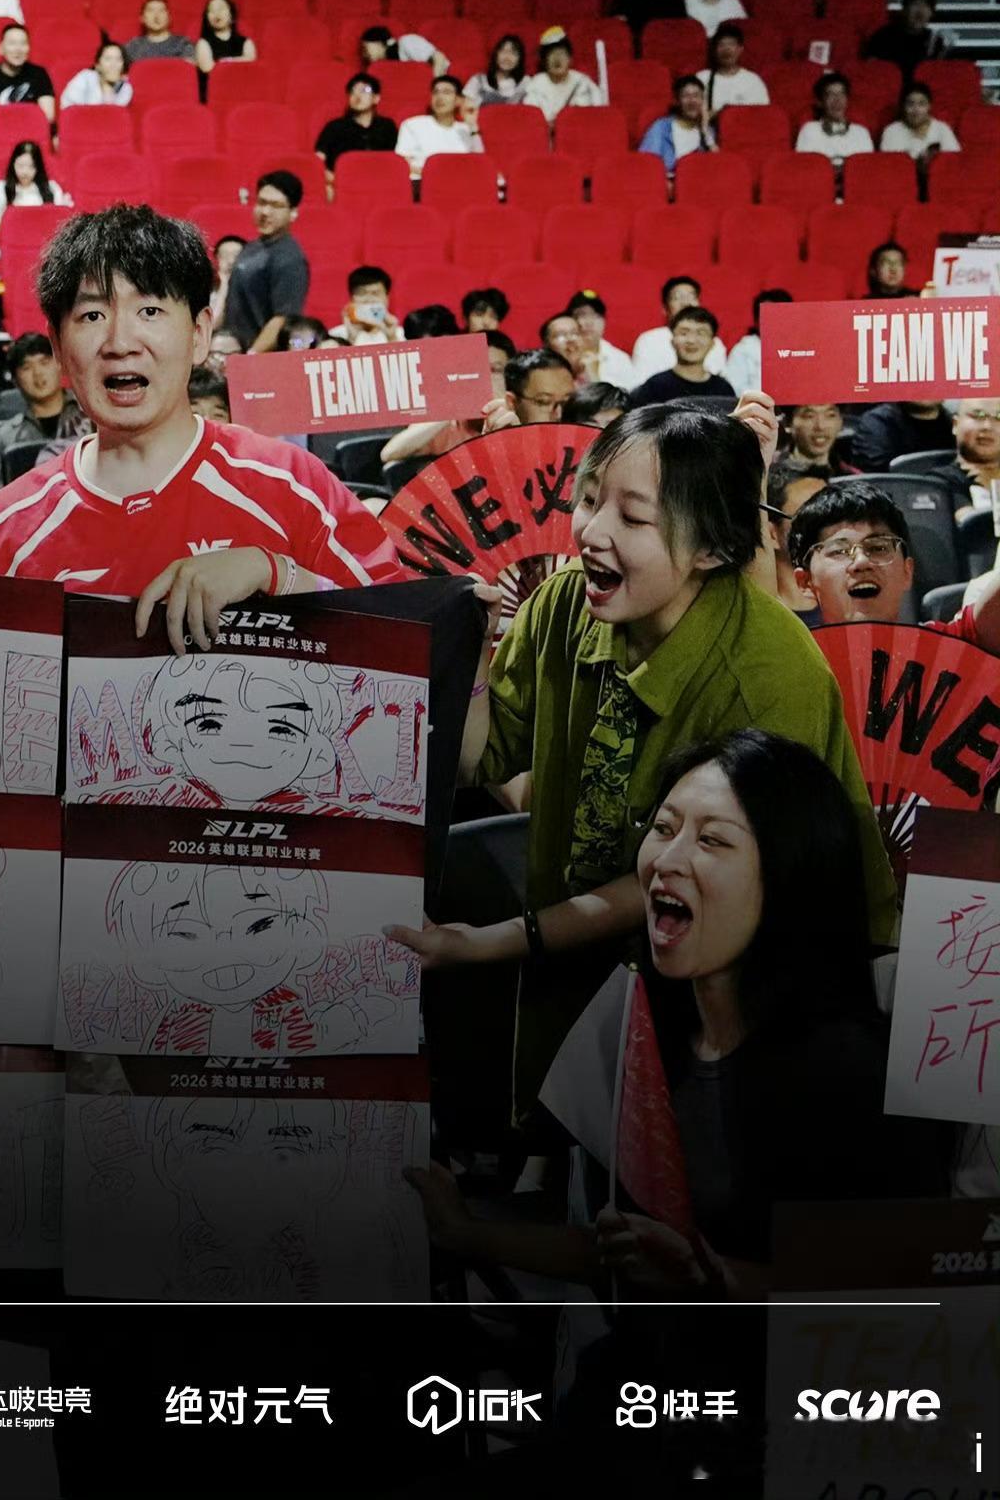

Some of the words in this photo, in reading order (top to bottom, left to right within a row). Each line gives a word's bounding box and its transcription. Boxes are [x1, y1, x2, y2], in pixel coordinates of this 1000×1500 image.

[852, 312, 936, 384] TEAM
[941, 310, 990, 381] WE
[303, 356, 379, 419] TEAM
[378, 351, 427, 411] WE
[395, 474, 522, 576] WE
[236, 611, 296, 632] LPL
[215, 633, 328, 655] 英雄联盟职业联赛
[863, 648, 1000, 798] WE
[231, 821, 290, 840] LPL
[168, 840, 206, 855] 2026
[208, 841, 322, 861] 英雄联盟职业联赛
[170, 1074, 208, 1088] 2026
